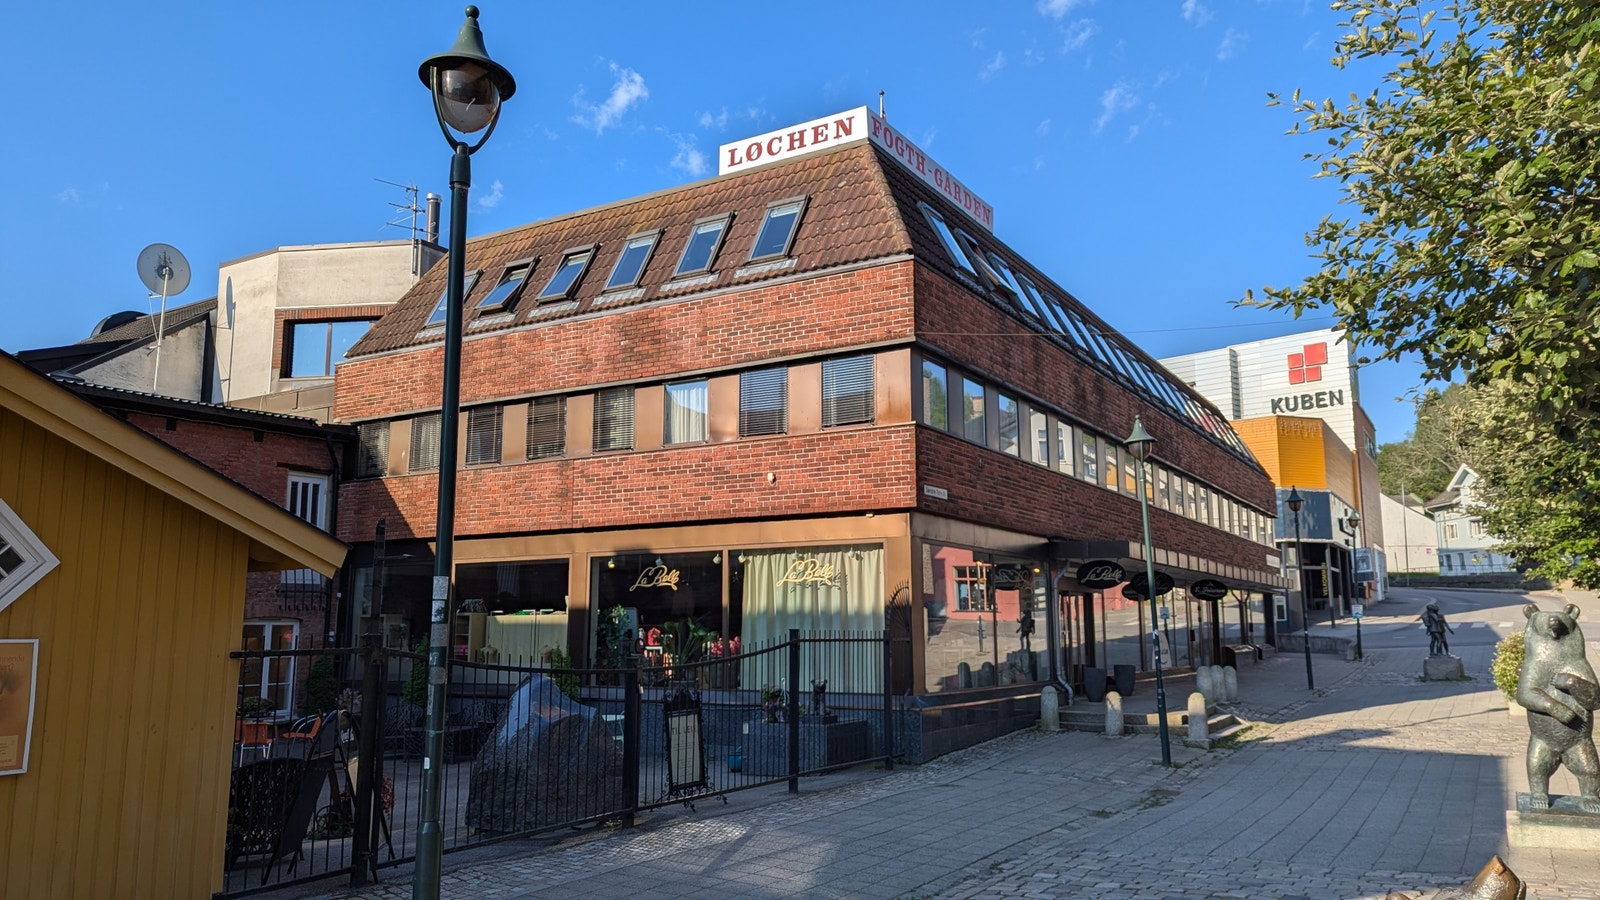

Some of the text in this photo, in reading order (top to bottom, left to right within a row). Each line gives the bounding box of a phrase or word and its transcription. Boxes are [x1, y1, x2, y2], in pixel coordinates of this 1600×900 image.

[728, 116, 855, 168] LØCHEN
[1271, 389, 1344, 414] KUBEN
[629, 564, 680, 591] La Belle
[776, 558, 833, 587] La Belle
[1081, 566, 1101, 583] La
[1099, 565, 1122, 583] Belle
